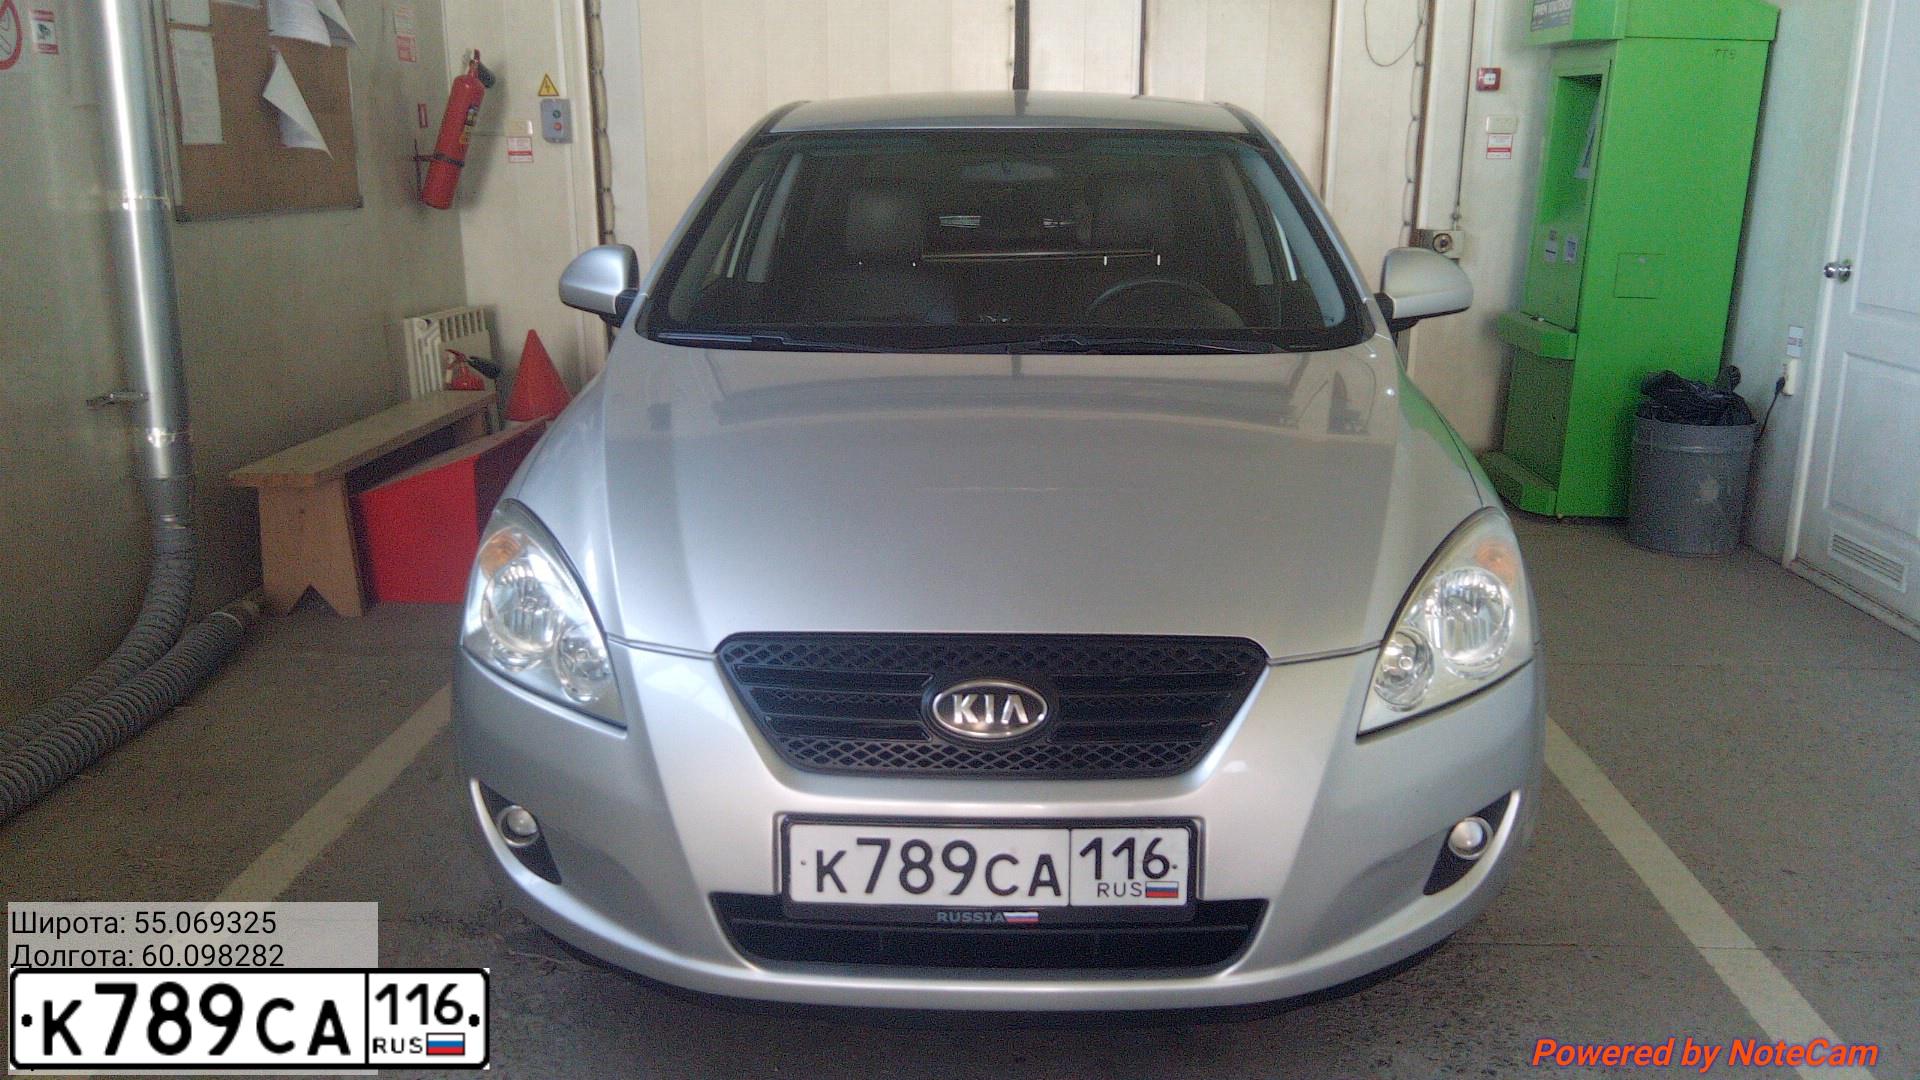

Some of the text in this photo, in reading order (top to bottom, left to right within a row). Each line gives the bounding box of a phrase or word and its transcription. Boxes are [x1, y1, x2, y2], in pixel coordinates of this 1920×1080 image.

[952, 694, 1029, 723] KIA
[1079, 837, 1171, 880] 116
[1097, 881, 1143, 898] RUS
[936, 911, 1006, 924] RUSSIA
